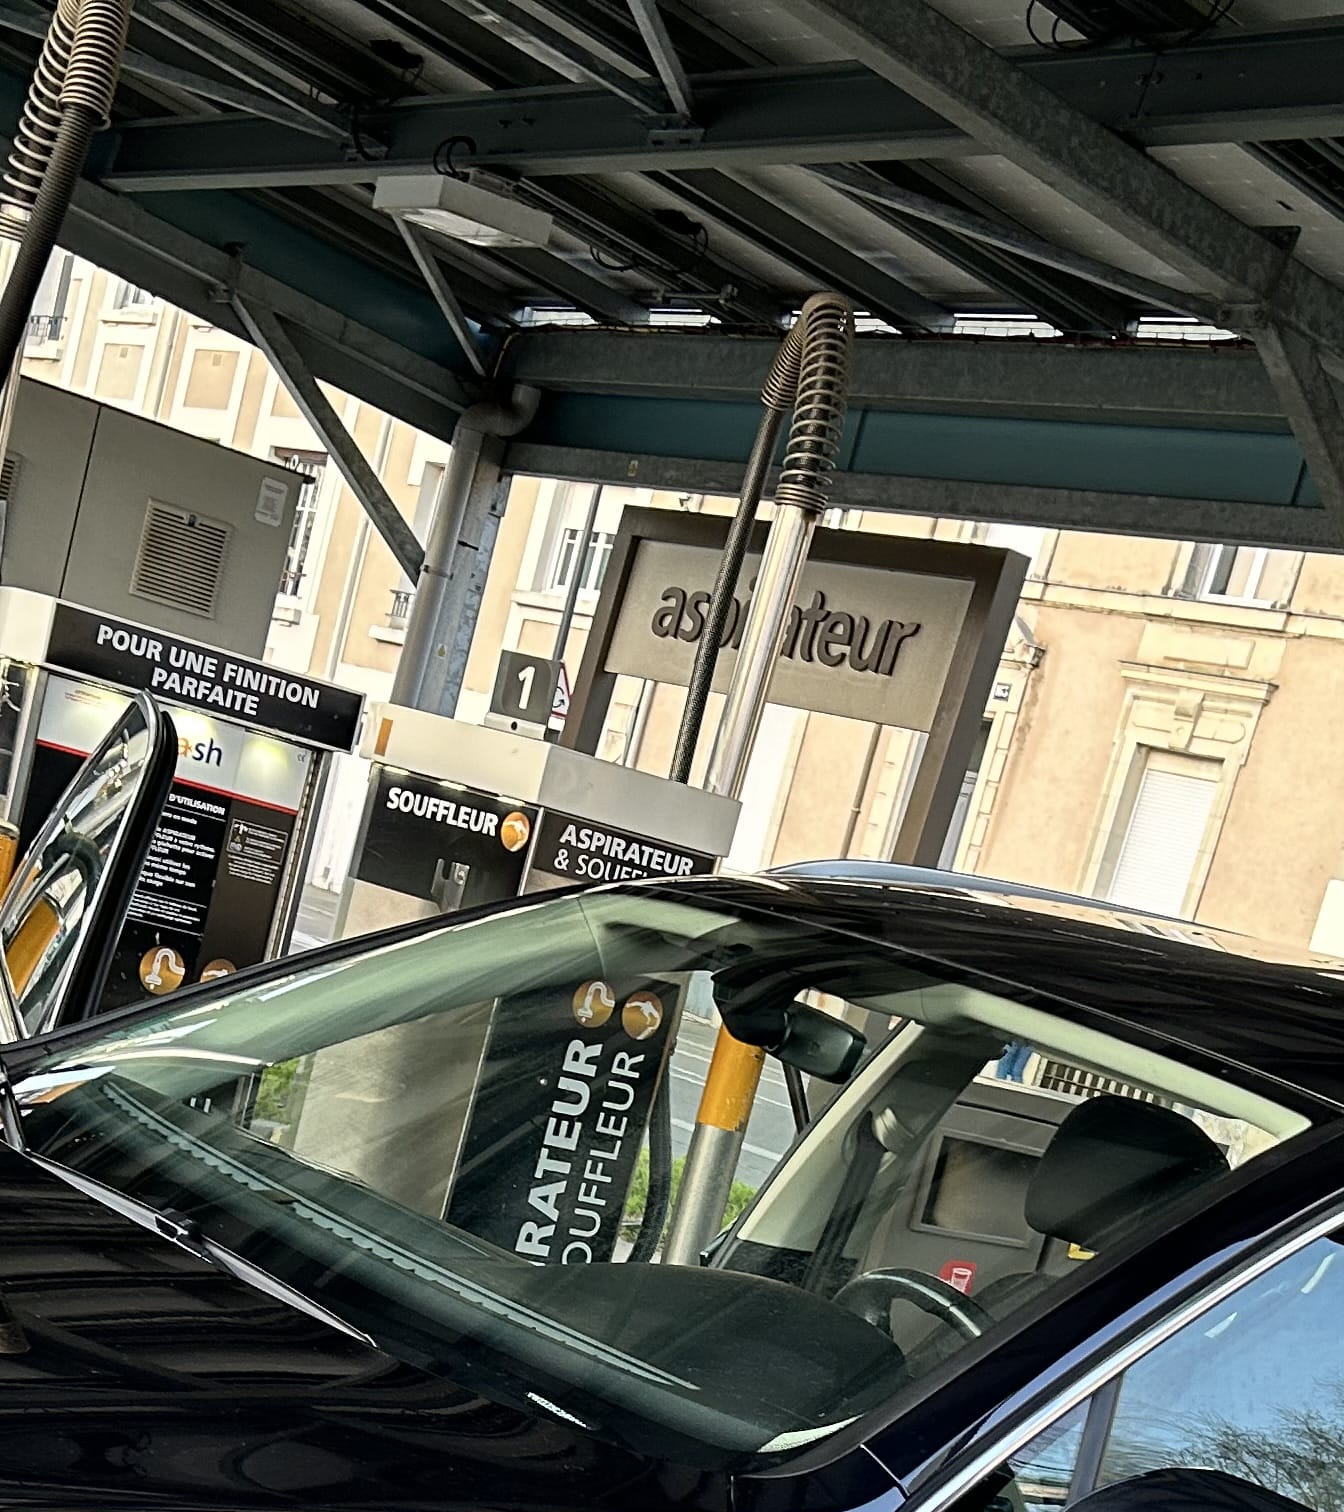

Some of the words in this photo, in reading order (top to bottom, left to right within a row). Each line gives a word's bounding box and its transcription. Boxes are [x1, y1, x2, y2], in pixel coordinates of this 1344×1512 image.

[97, 623, 162, 662] POUR
[169, 646, 218, 679] UNE
[223, 661, 320, 709] FINITION
[517, 665, 537, 711] 1
[152, 667, 260, 716] PARFAITE
[386, 785, 499, 838] SOUFFLEUR
[554, 848, 570, 871] &
[559, 824, 694, 876] ASPIRATEUR
